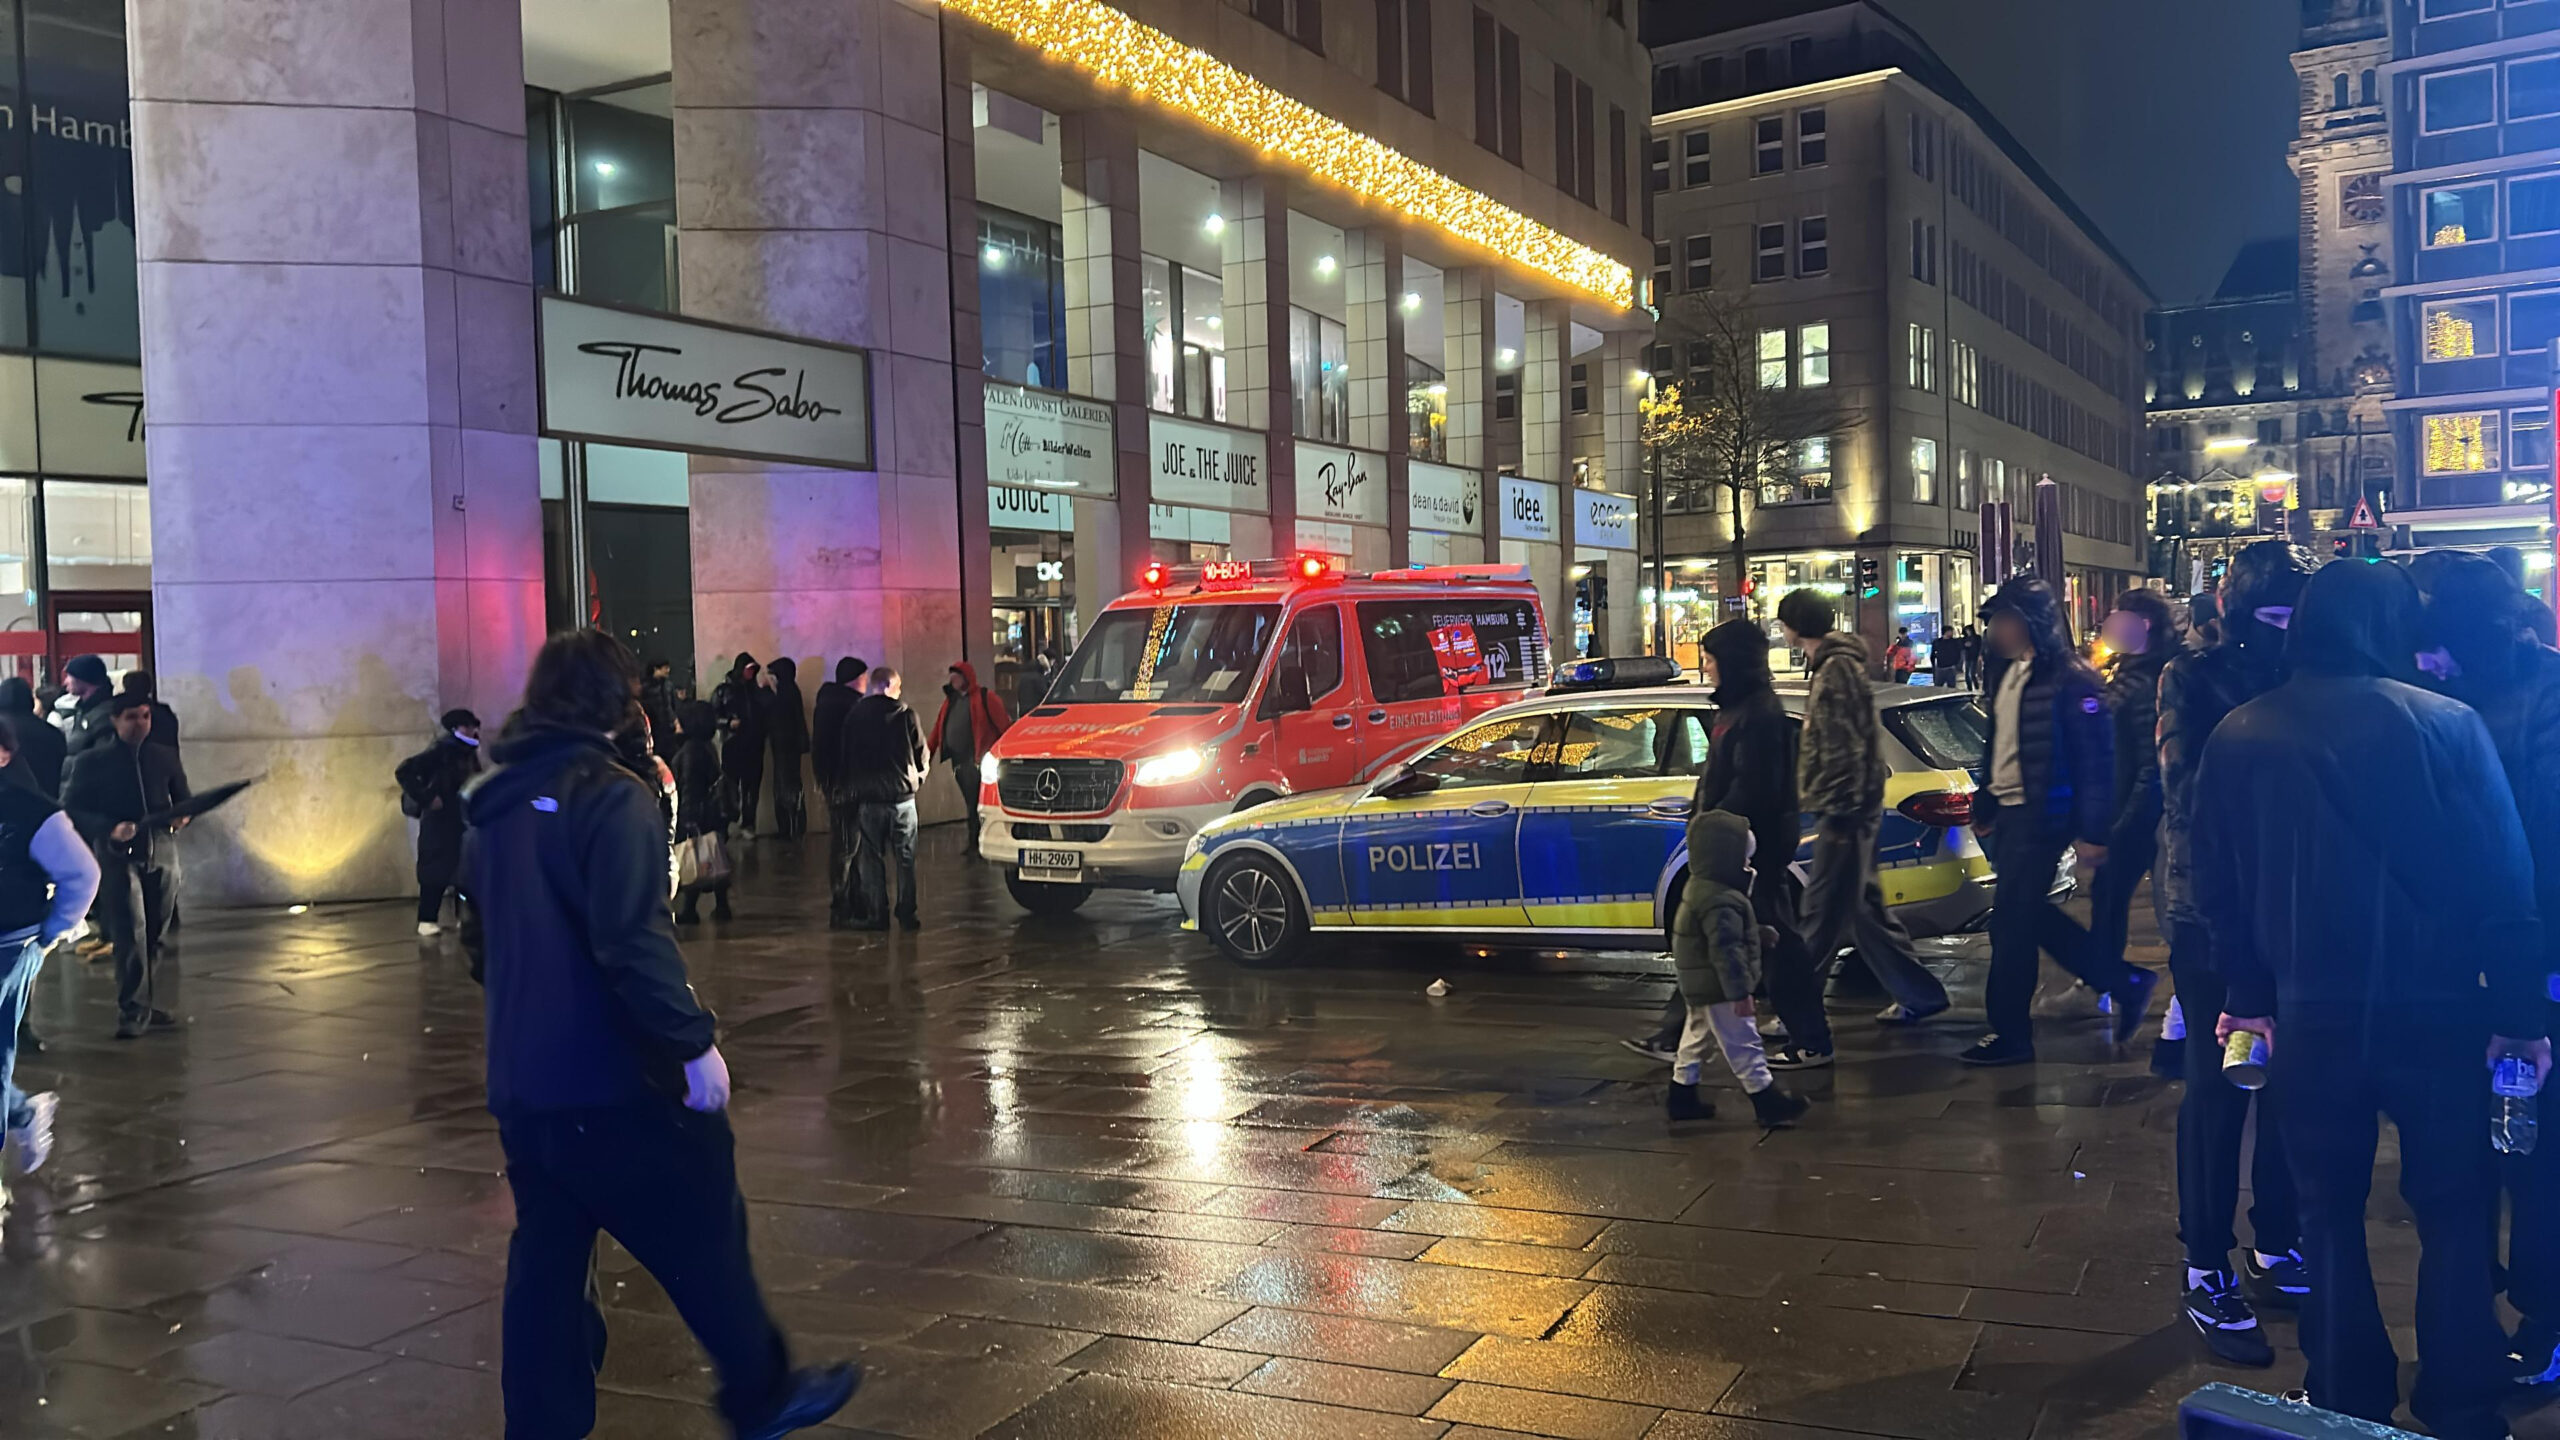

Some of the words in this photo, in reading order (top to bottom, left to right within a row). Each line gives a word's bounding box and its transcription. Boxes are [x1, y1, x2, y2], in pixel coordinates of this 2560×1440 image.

[577, 341, 721, 417] Thomas
[715, 367, 842, 424] Sabo
[1162, 442, 1186, 476] JOE
[1196, 447, 1220, 481] THE
[1223, 452, 1258, 486] JUICE
[1512, 487, 1544, 523] idee.
[1590, 501, 1623, 529] ecco
[1475, 612, 1509, 627] HAMBURG
[1018, 722, 1145, 737] FEUERWHR
[1028, 851, 1042, 865] HH
[1047, 852, 1075, 867] 2969
[1368, 842, 1481, 873] POLIZEI
